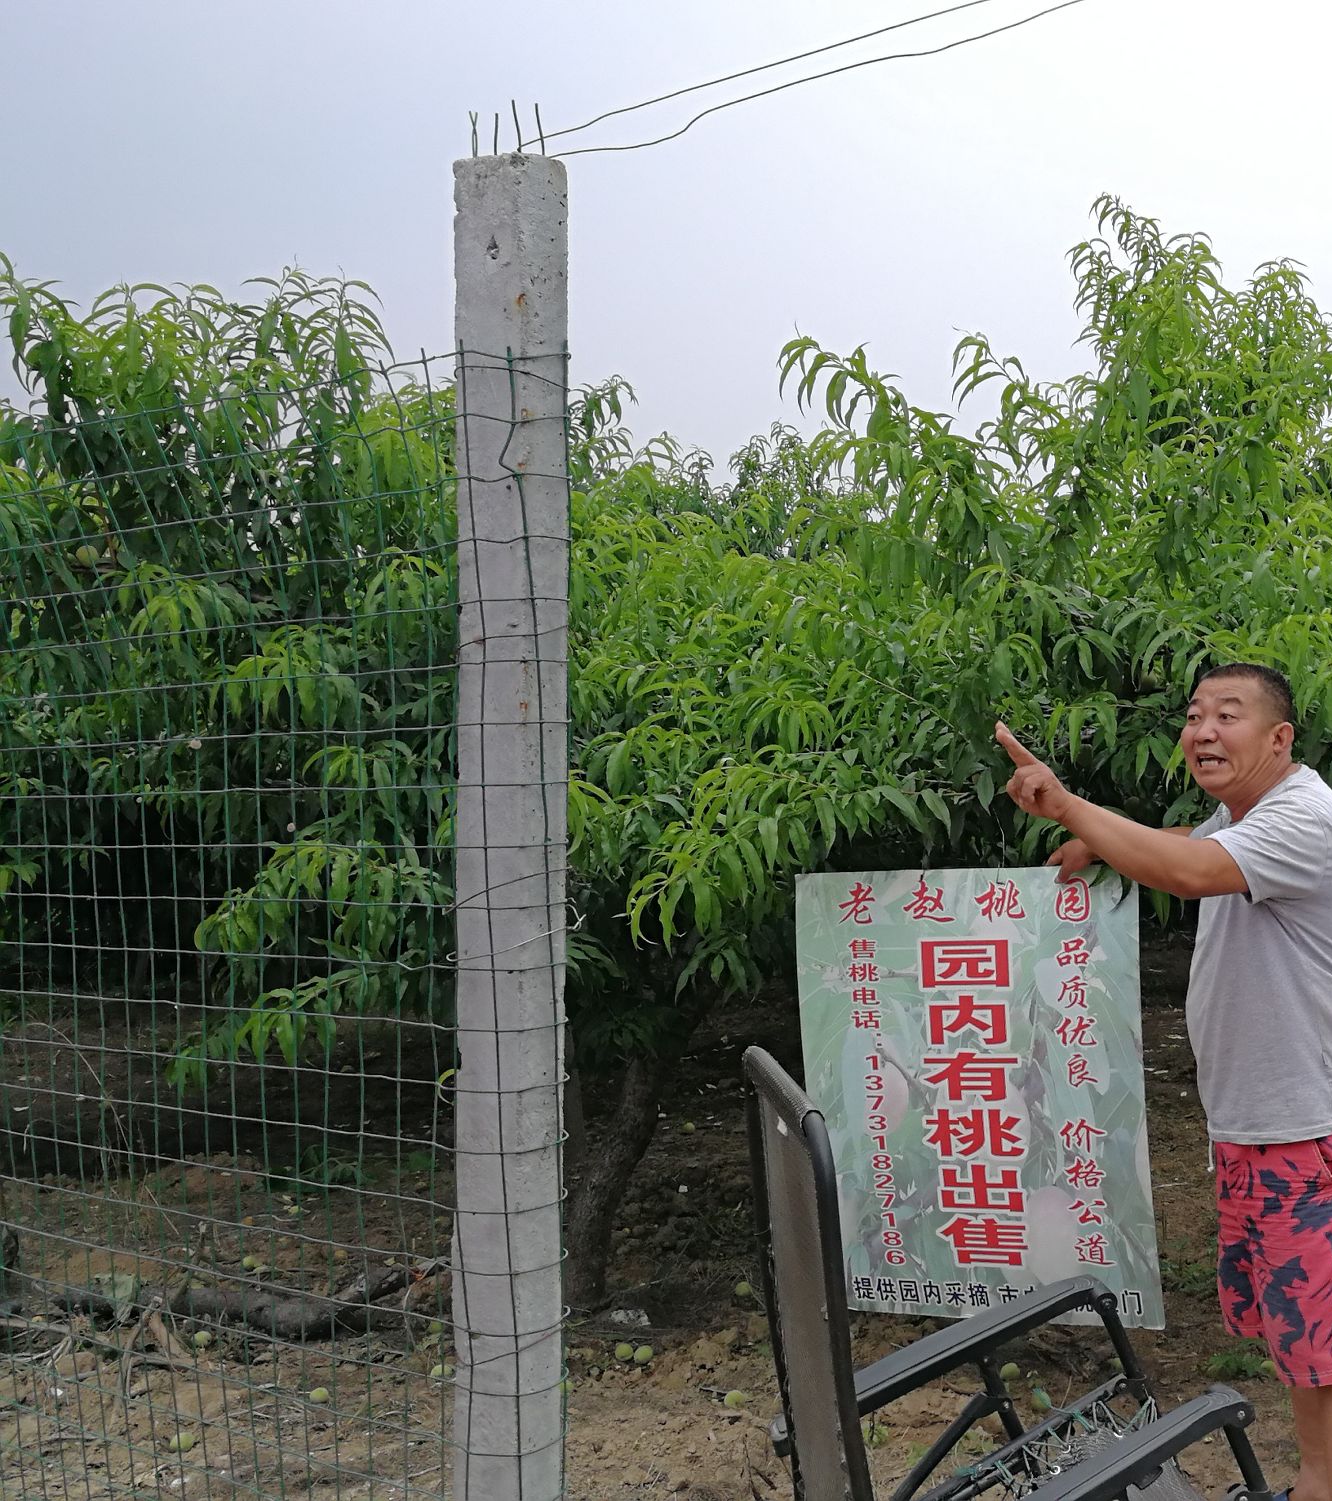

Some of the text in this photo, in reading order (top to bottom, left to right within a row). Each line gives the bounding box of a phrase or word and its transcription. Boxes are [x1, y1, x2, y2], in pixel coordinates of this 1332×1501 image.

[920, 939, 1029, 1266] 园内有桃出售
[1056, 937, 1117, 1266] 品质优良 价格公道
[853, 1276, 990, 1308] 提供园内采摘
